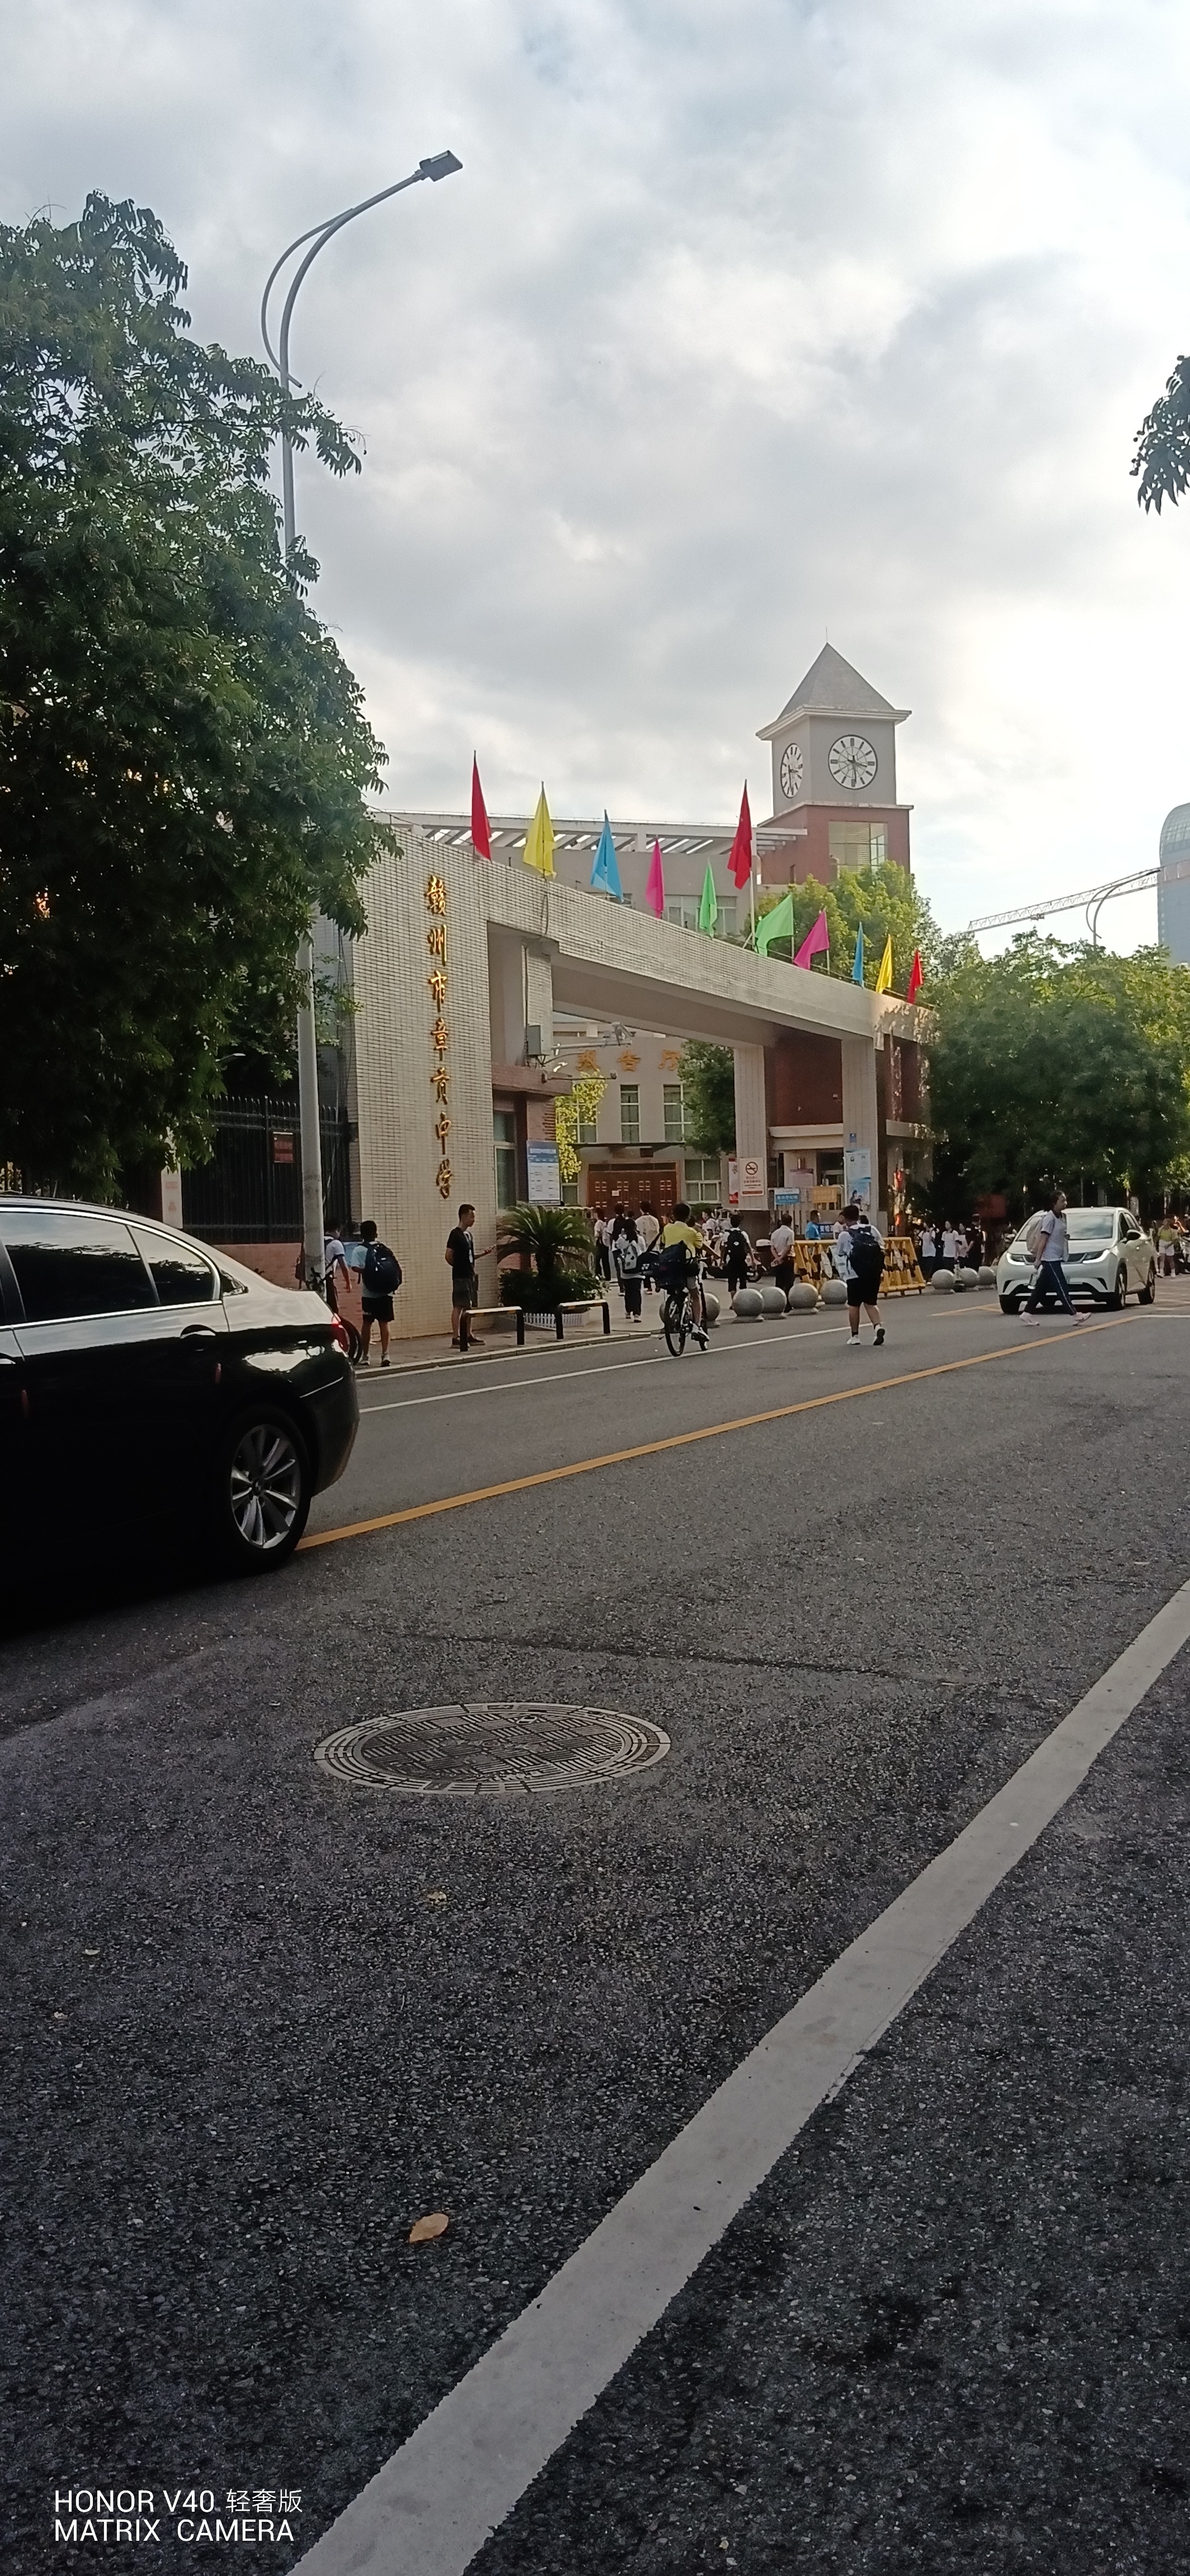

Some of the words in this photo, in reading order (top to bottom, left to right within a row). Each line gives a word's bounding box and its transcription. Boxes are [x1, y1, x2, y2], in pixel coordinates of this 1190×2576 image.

[426, 875, 453, 1199] 赣州市章贡中学
